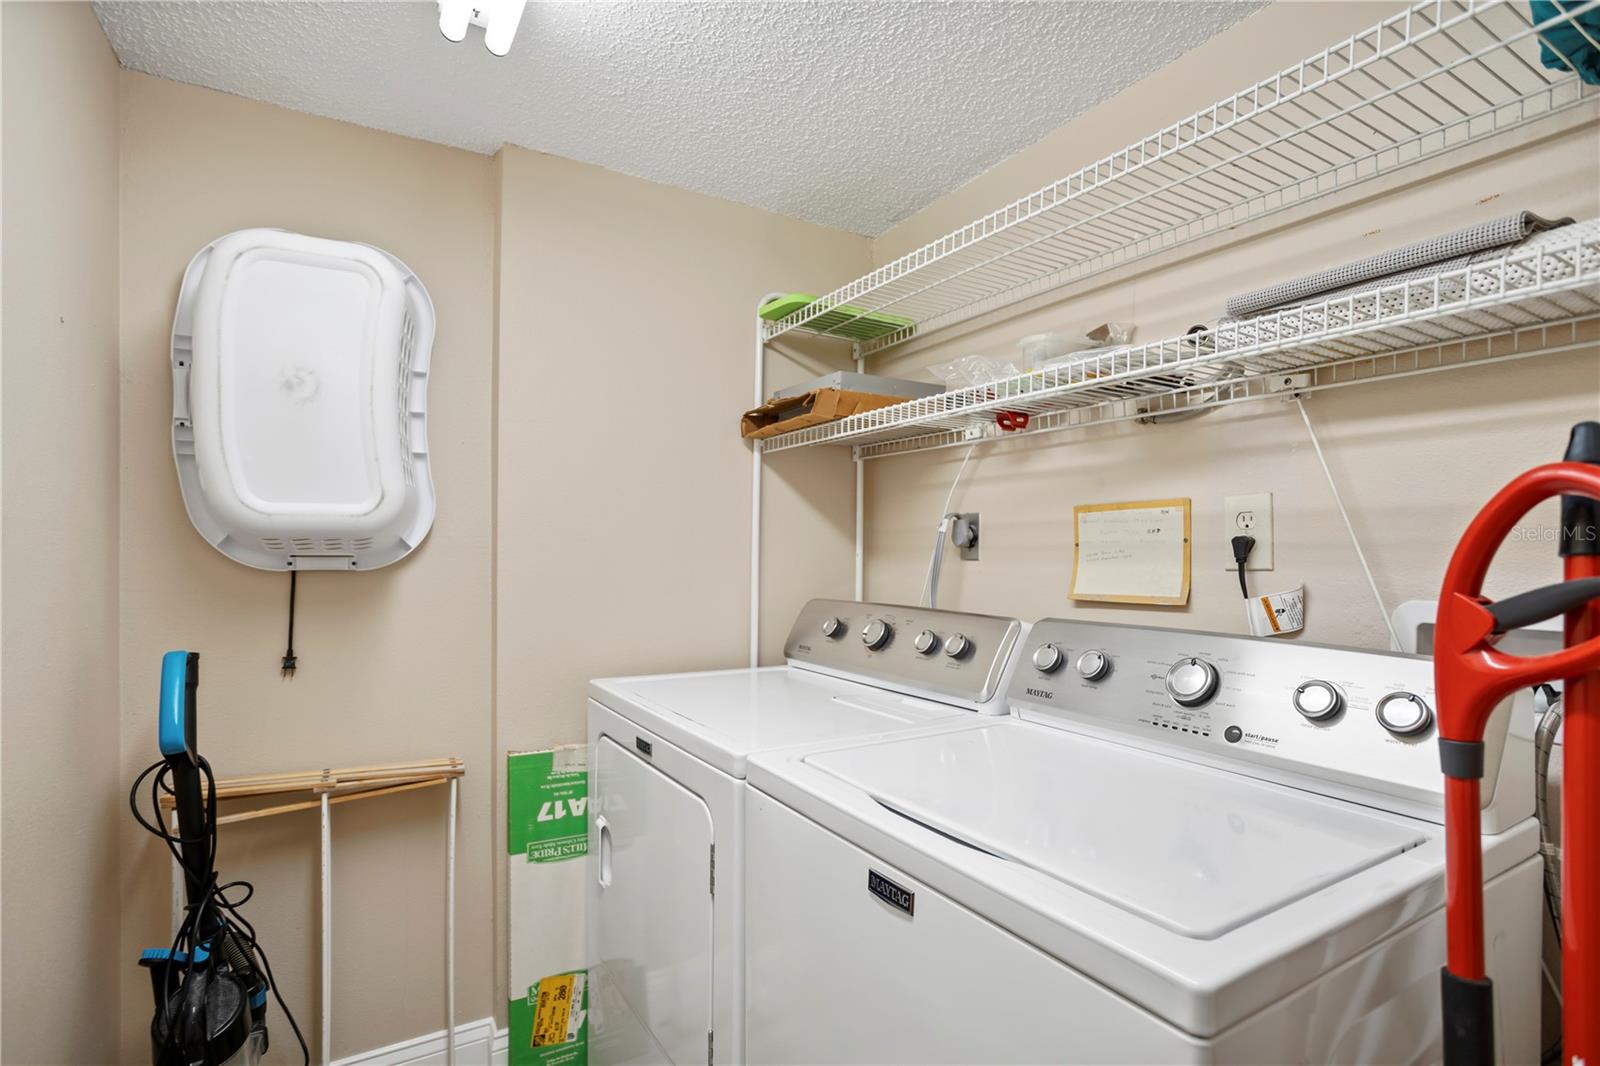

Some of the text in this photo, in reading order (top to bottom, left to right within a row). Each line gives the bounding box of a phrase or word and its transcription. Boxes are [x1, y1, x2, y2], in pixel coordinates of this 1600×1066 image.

[1026, 687, 1053, 700] MAYTAG
[1244, 732, 1280, 743] start/pause
[537, 797, 588, 822] A17
[532, 846, 561, 858] PRIDE
[869, 874, 911, 908] MAYTAG
